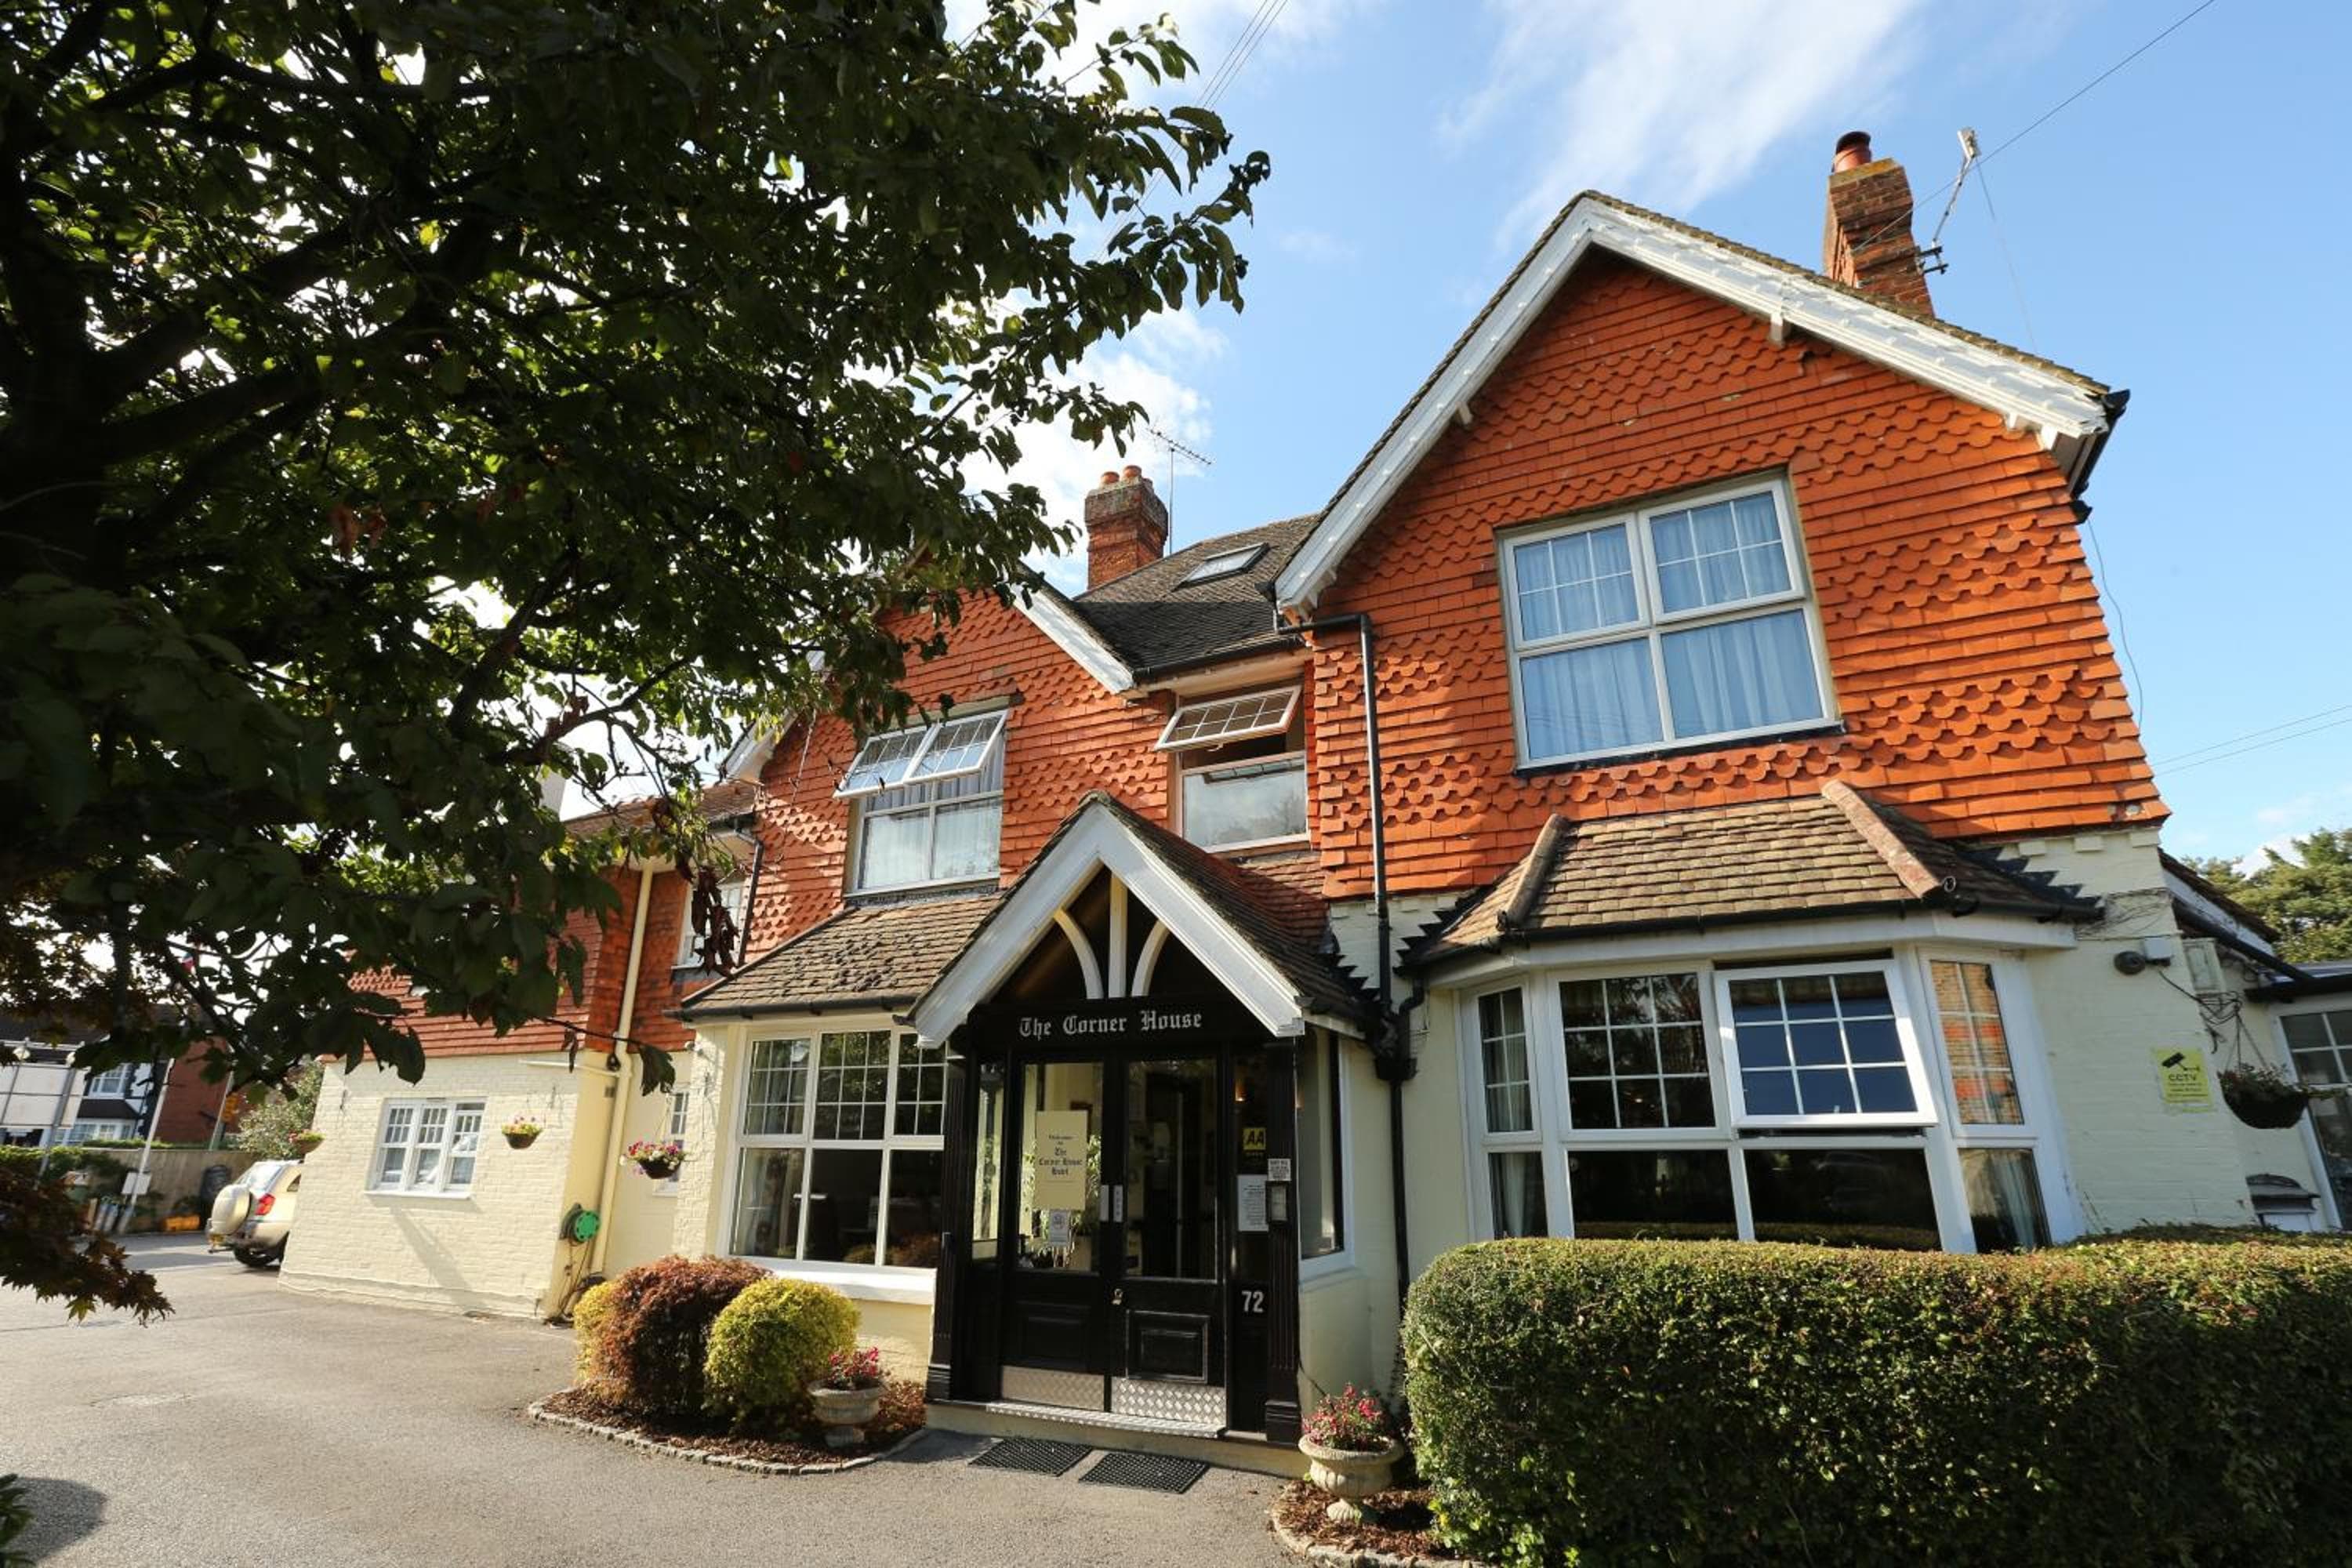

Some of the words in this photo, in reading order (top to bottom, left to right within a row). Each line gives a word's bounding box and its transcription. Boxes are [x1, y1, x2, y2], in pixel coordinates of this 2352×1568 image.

[1019, 1017, 1051, 1040] The
[1062, 1015, 1127, 1036] Corner
[1141, 1010, 1202, 1031] House
[1246, 1130, 1265, 1145] AA
[1242, 1290, 1264, 1313] 72
